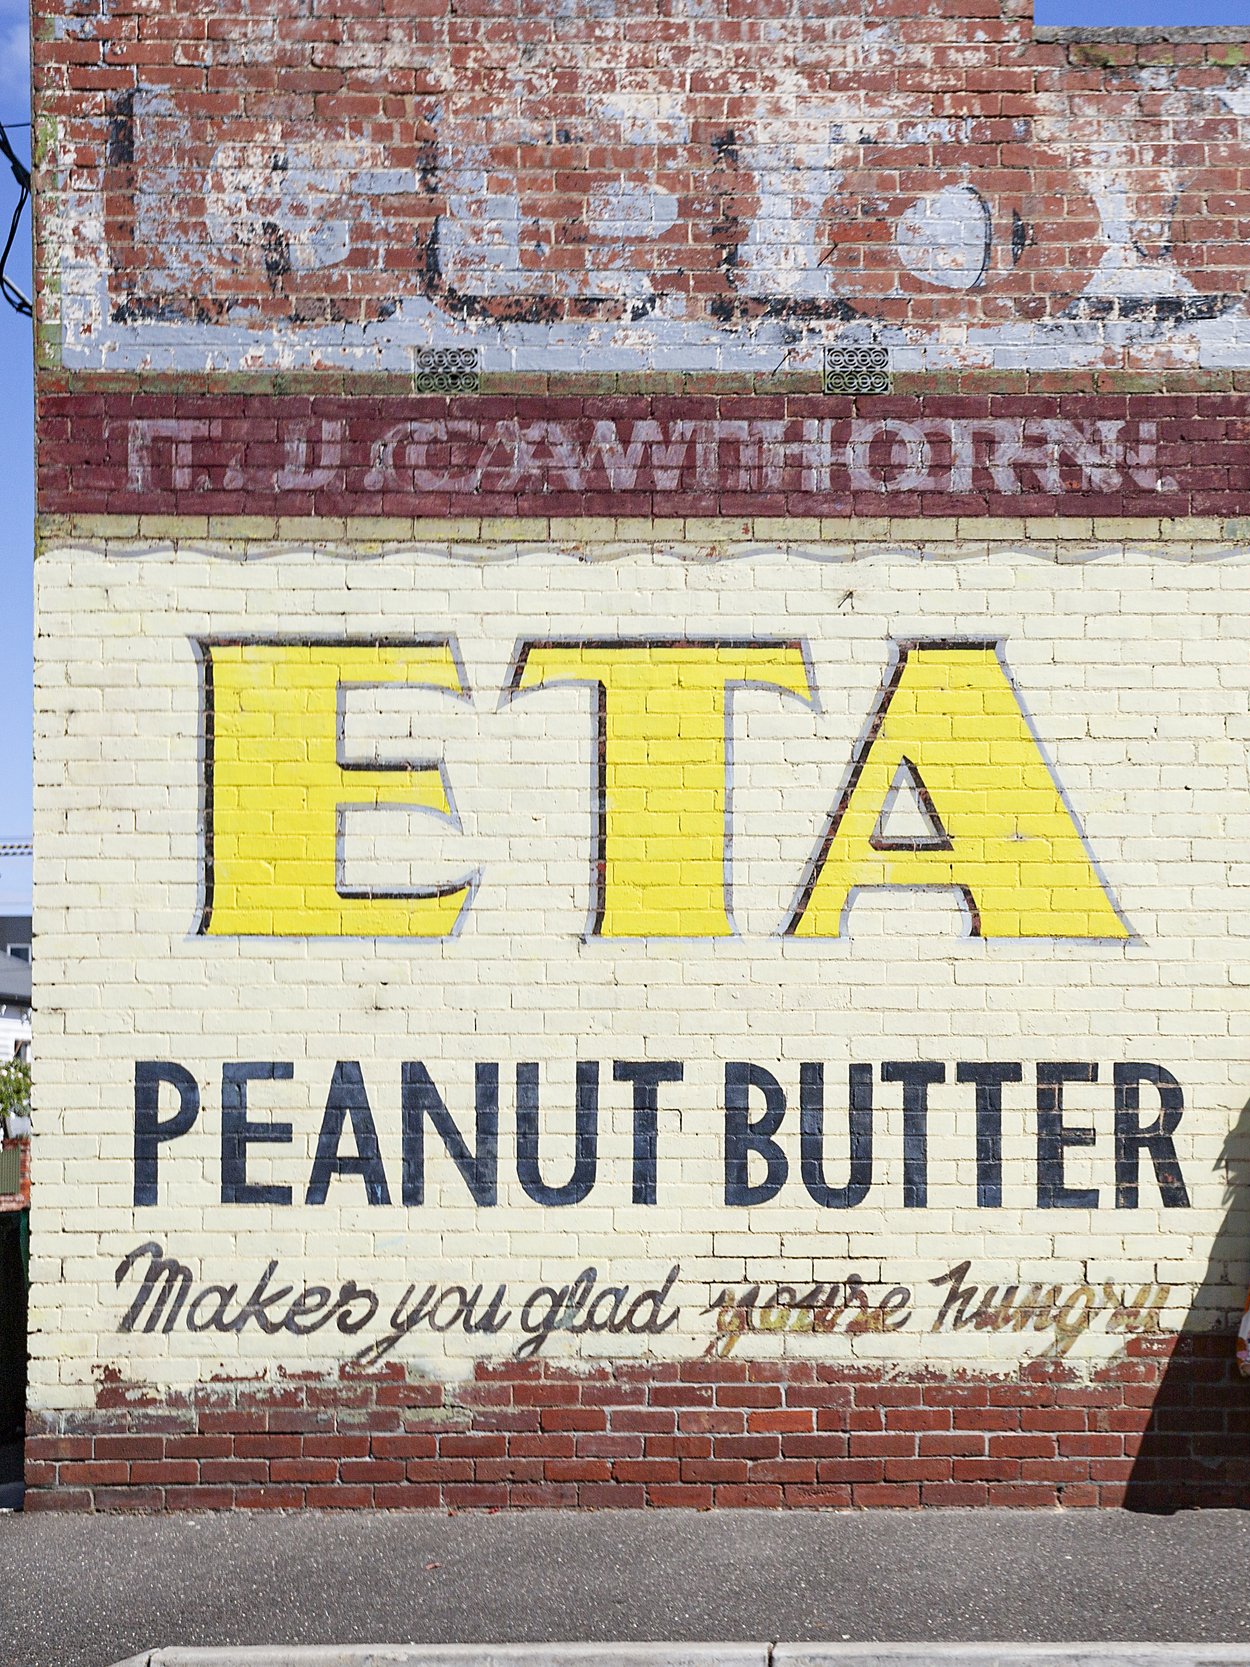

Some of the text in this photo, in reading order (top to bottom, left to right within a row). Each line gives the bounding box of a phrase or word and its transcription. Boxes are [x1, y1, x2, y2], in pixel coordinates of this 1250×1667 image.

[184, 632, 1147, 947] ETA
[133, 1060, 1190, 1209] PEANUT BUTTER
[114, 1241, 379, 1334] Makes
[350, 1282, 512, 1368] you
[519, 1263, 680, 1359] glad
[927, 1260, 1176, 1365] hungry
